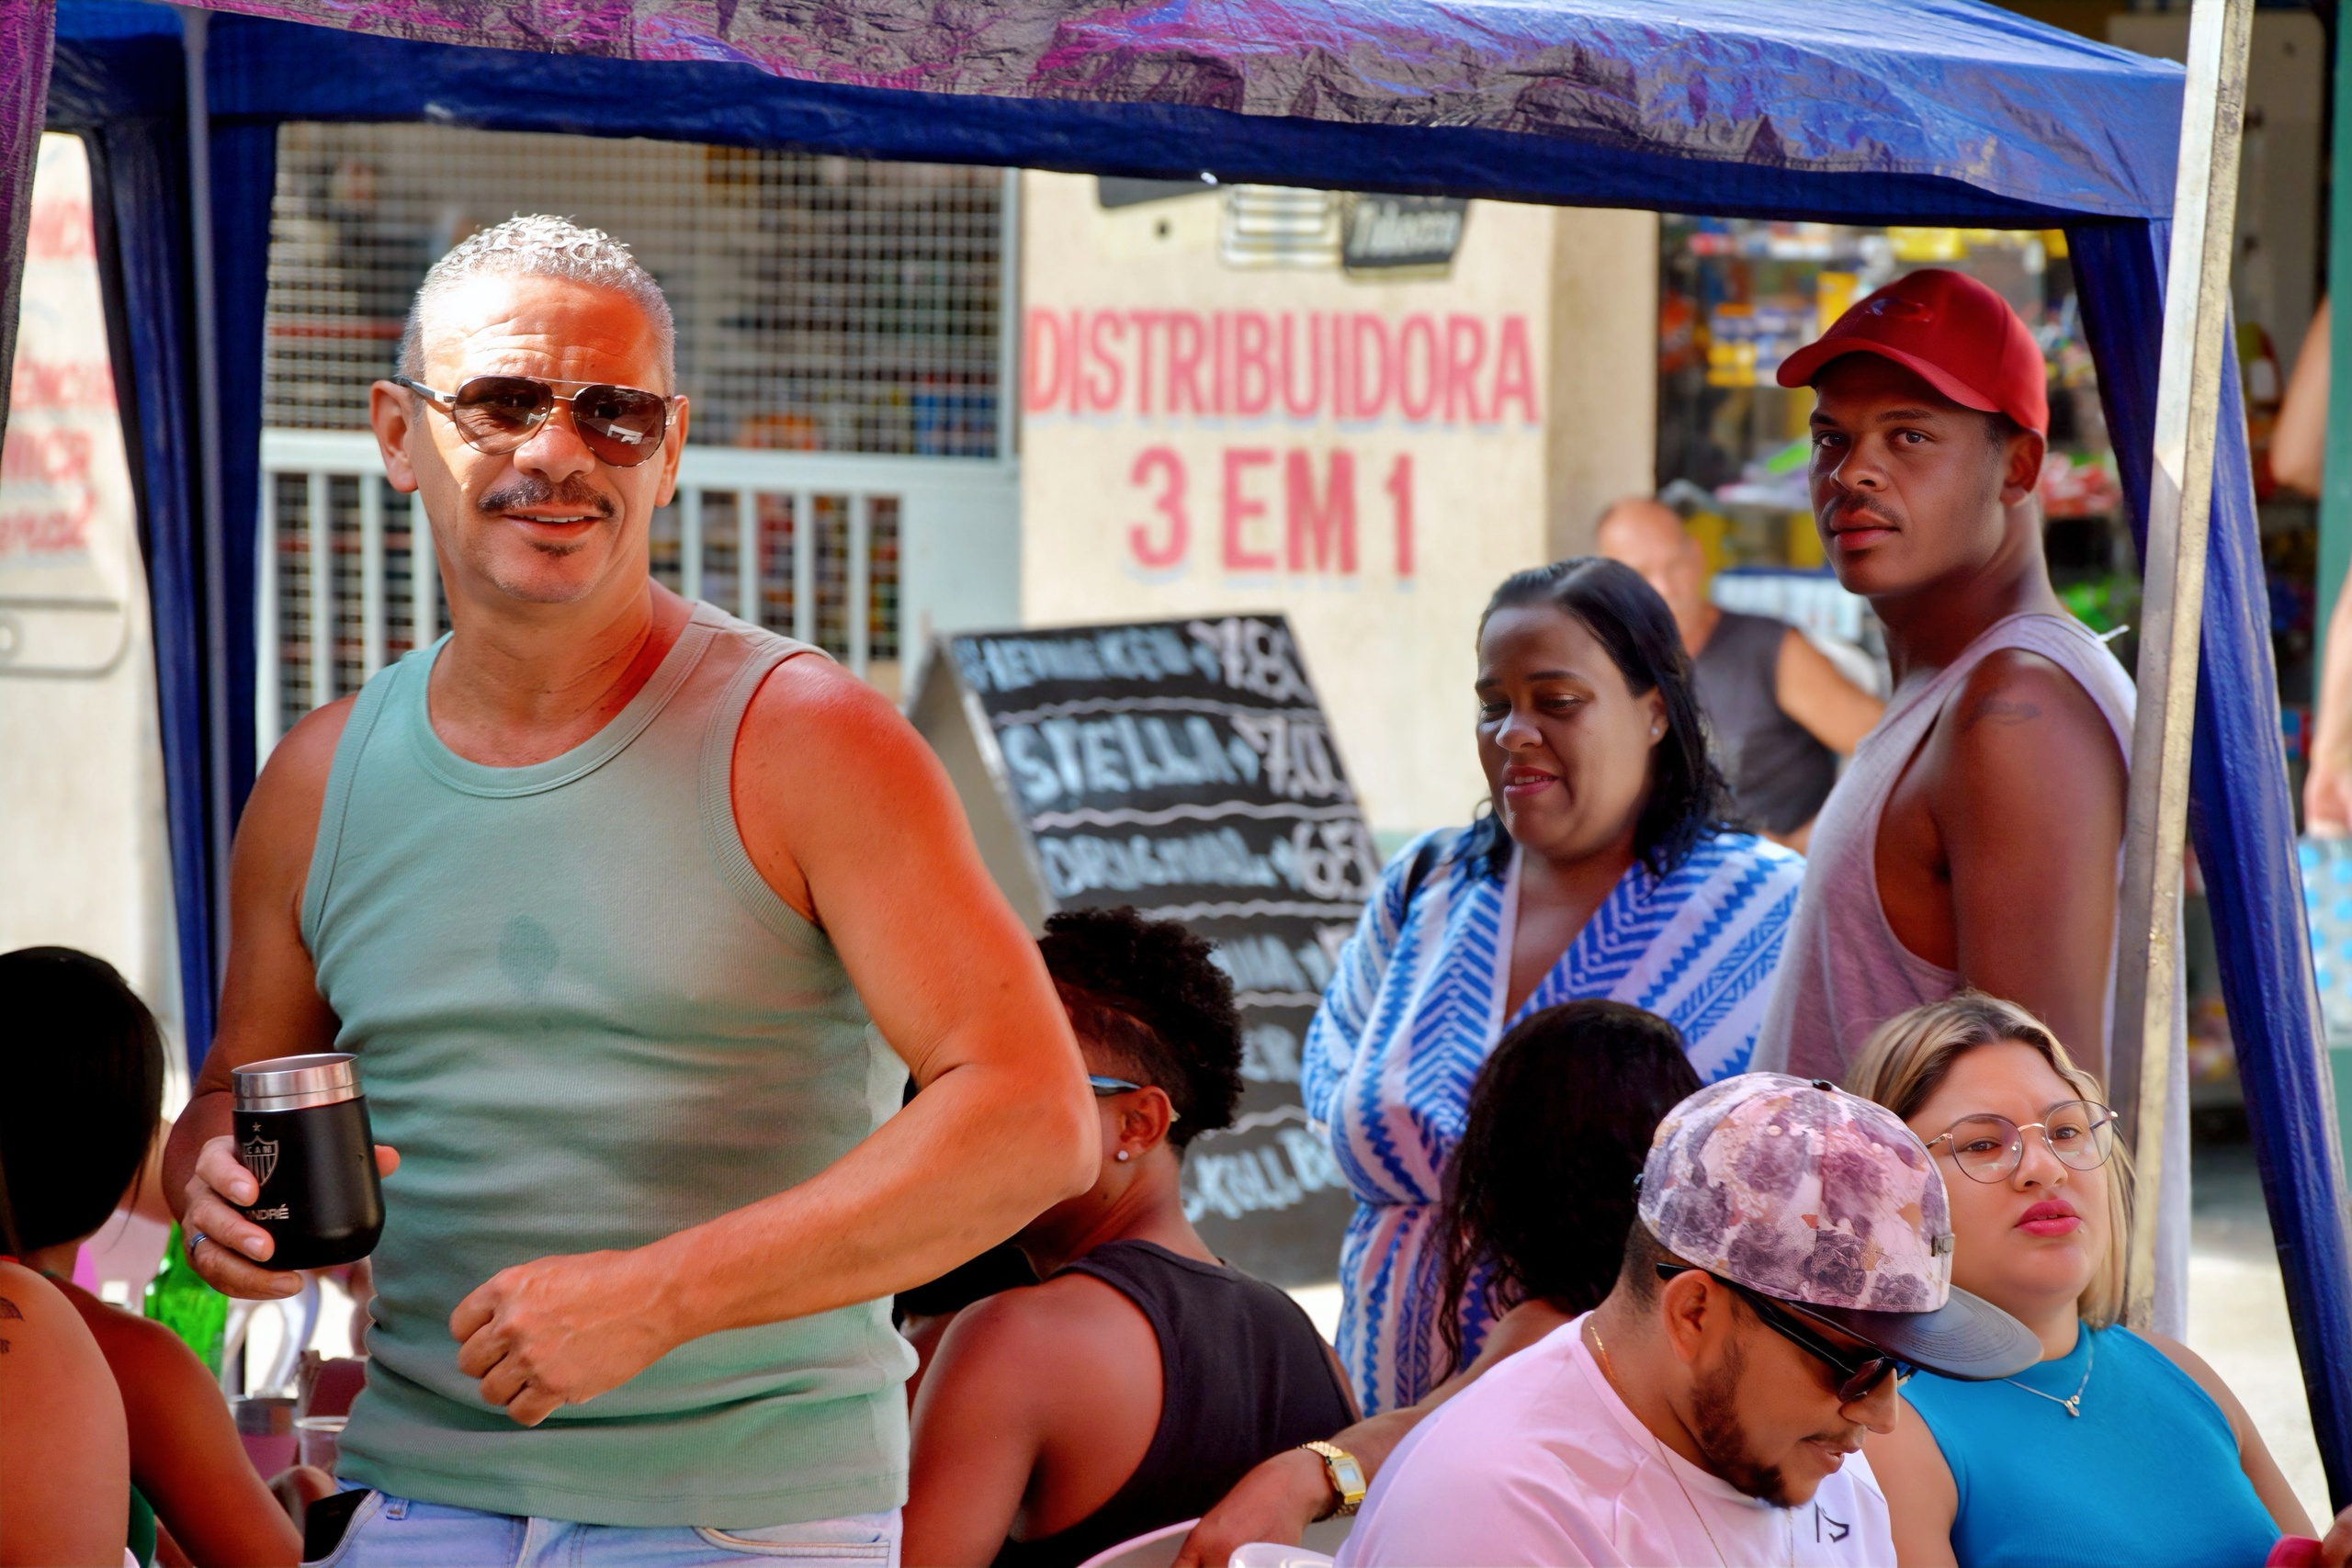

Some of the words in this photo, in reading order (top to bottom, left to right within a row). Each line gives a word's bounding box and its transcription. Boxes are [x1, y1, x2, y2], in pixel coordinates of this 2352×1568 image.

[1023, 305, 1540, 424] DISTRIBUIDORA
[1128, 446, 1189, 571] 3
[1221, 448, 1358, 576] EM
[1385, 452, 1415, 577] 1
[1001, 715, 1238, 805] STELLA
